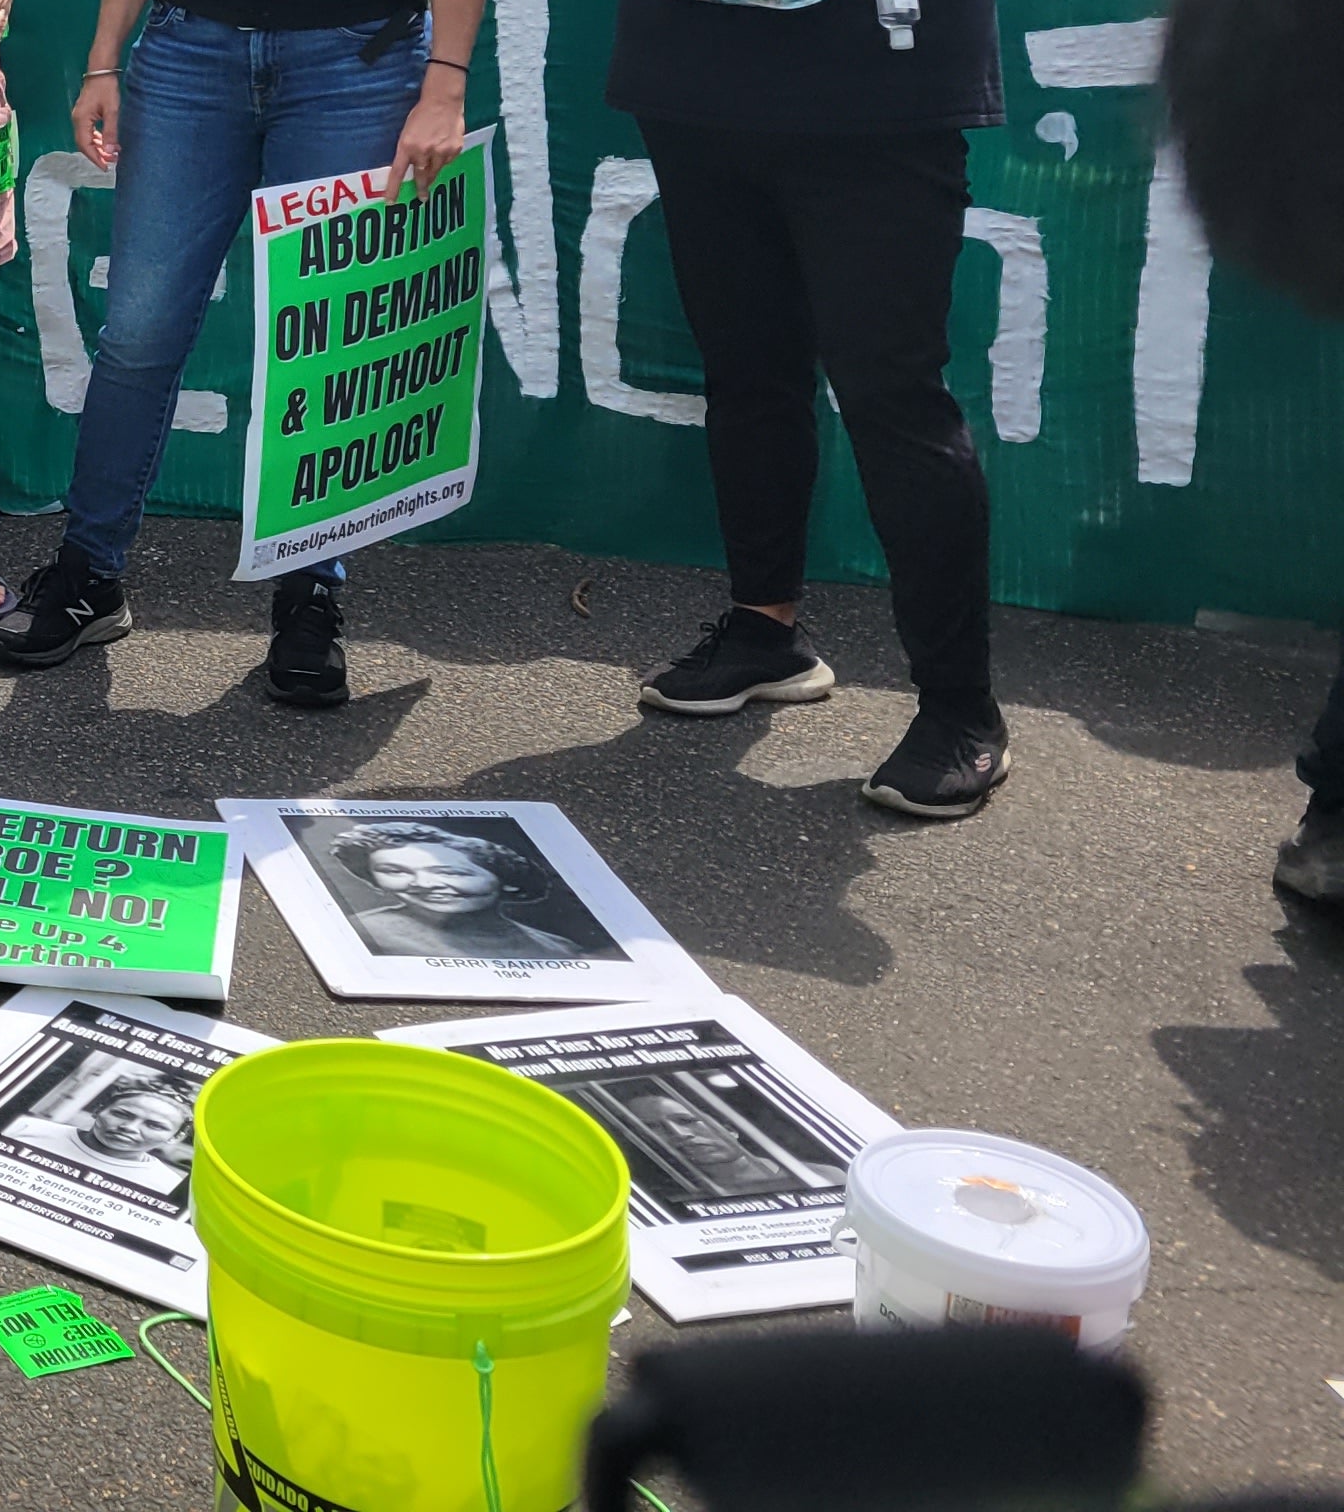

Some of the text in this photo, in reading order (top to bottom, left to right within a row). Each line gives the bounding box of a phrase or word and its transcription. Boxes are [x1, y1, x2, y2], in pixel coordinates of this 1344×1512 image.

[256, 171, 386, 236] LEGAL
[298, 172, 467, 278] ABORTION
[275, 245, 482, 361] ON DEMAND
[280, 325, 472, 437] & WITHOUT
[290, 403, 446, 509] APOLOGY
[275, 478, 466, 562] RiseUp4AbortionRights.org
[277, 805, 512, 819] RiseUp4AbortionRights.org
[93, 859, 132, 887] ?
[68, 887, 168, 930] NO!
[31, 920, 85, 946] Up
[97, 934, 130, 955] 4
[424, 956, 591, 972] GERRI SANTORO
[493, 969, 531, 981] 1964
[16, 1198, 73, 1225] ABORTION
[73, 1220, 116, 1241] RIGHTS
[28, 1183, 106, 1218] Miscarriage
[34, 1174, 103, 1206] Sentenced
[103, 1200, 124, 1213] 30
[126, 1208, 163, 1228] Years
[743, 1252, 774, 1264] RISE
[772, 1250, 791, 1261] UP
[793, 1248, 816, 1259] FOR
[62, 1321, 110, 1342] ROE?
[29, 1337, 123, 1370] OVERTURN
